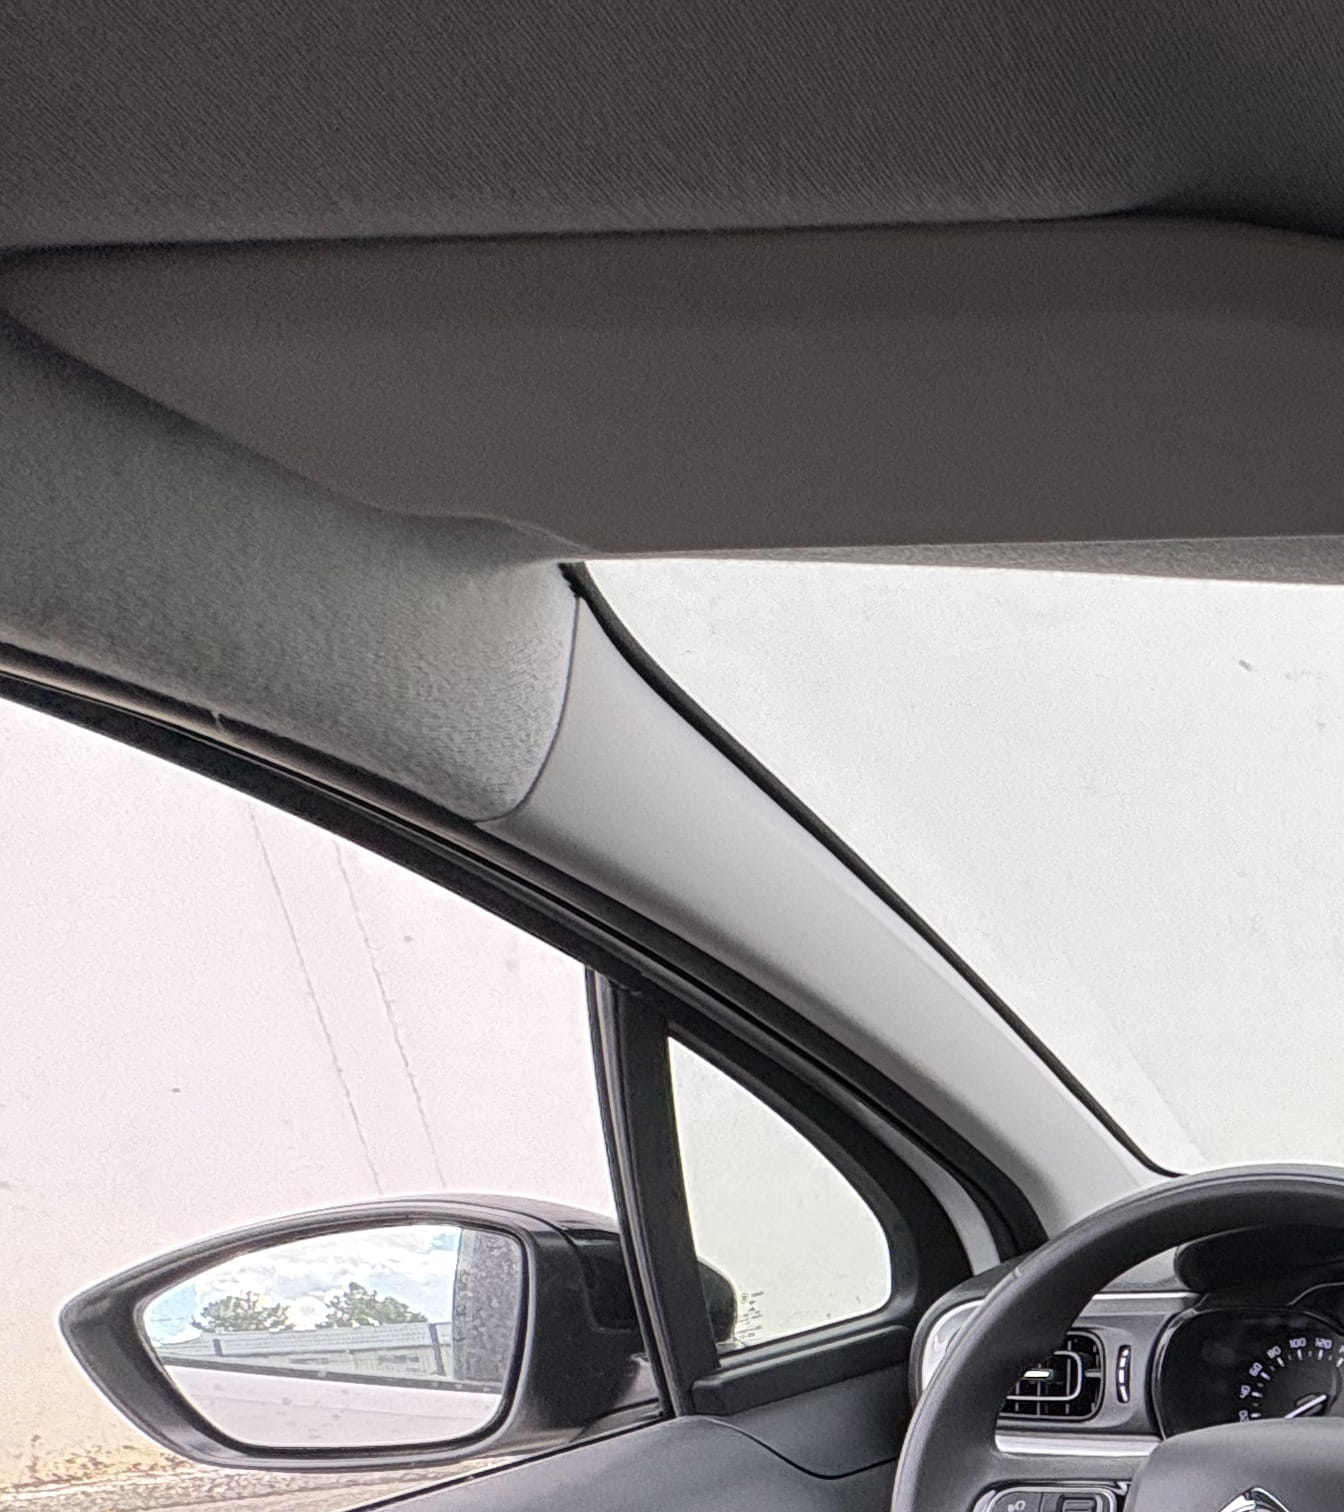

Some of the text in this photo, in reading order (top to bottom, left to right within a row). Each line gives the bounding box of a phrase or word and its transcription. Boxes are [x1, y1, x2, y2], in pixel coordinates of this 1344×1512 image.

[1289, 1337, 1307, 1349] 100
[1315, 1337, 1333, 1349] 120
[1266, 1345, 1282, 1360] 80
